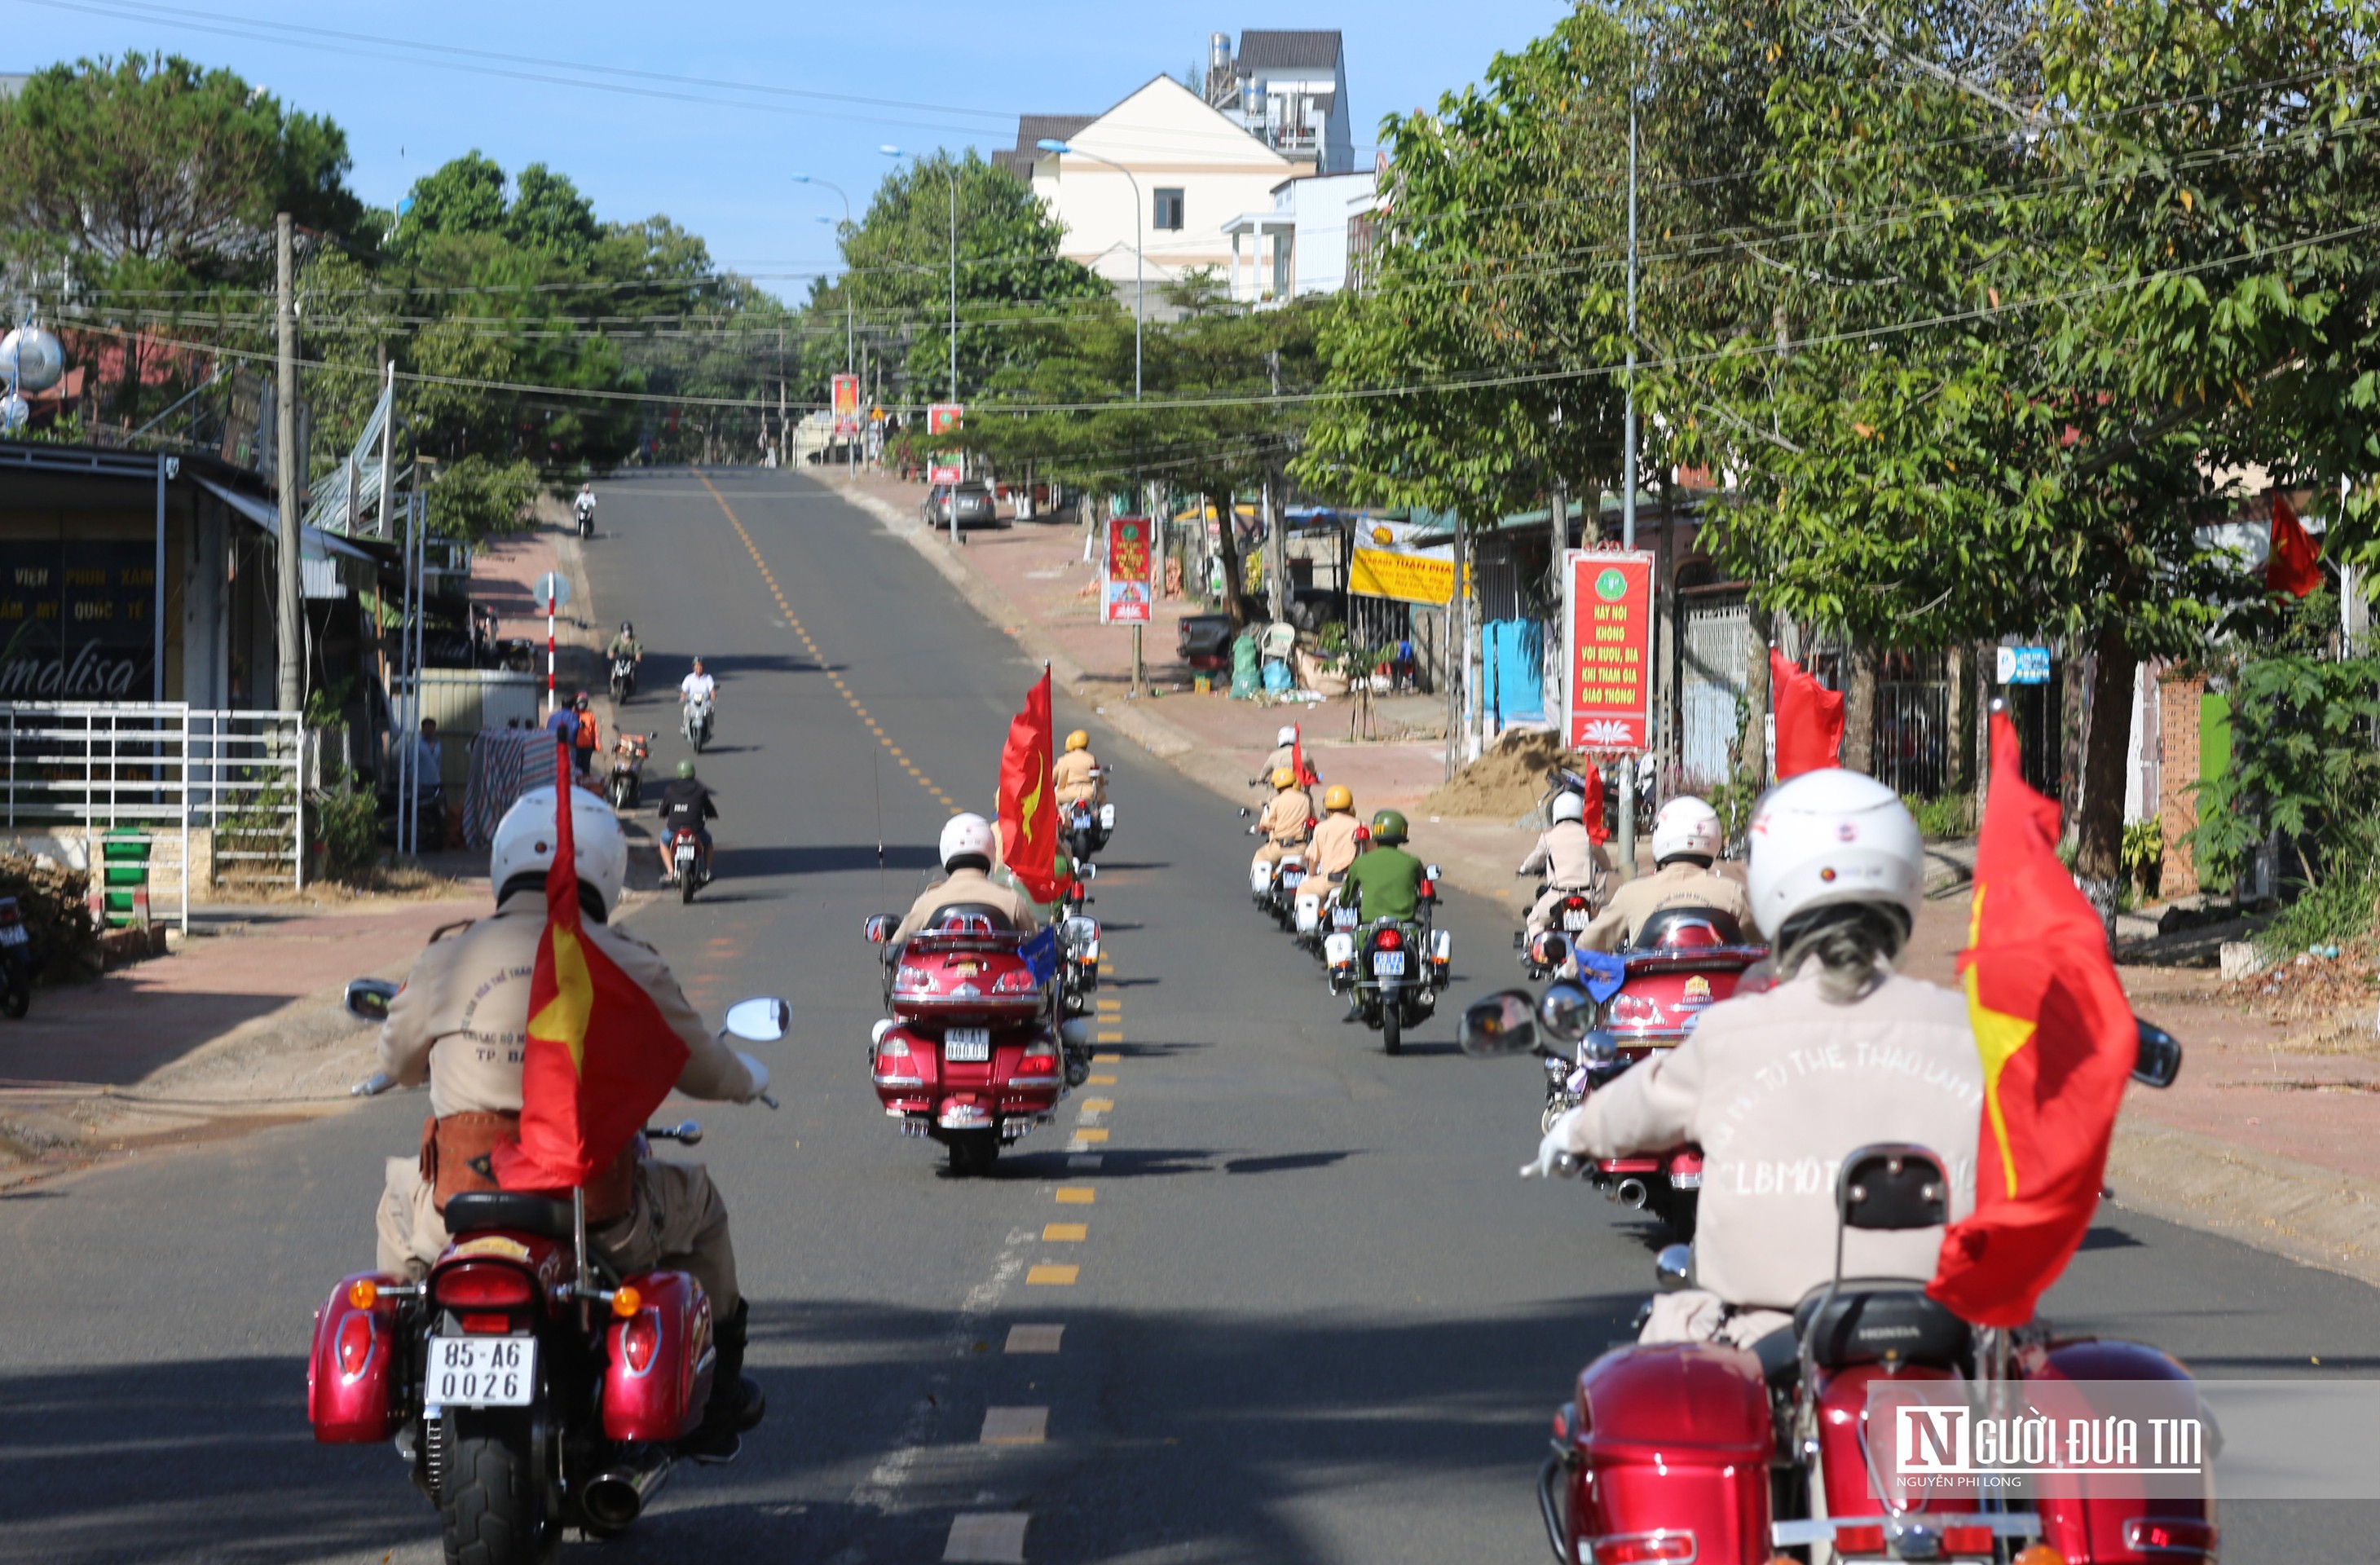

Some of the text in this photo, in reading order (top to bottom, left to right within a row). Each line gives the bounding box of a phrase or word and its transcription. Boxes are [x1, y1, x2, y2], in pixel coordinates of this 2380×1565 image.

[1858, 1326, 1921, 1341] HONDA
[444, 1342, 521, 1368] 85-A6
[442, 1373, 518, 1399] 0026
